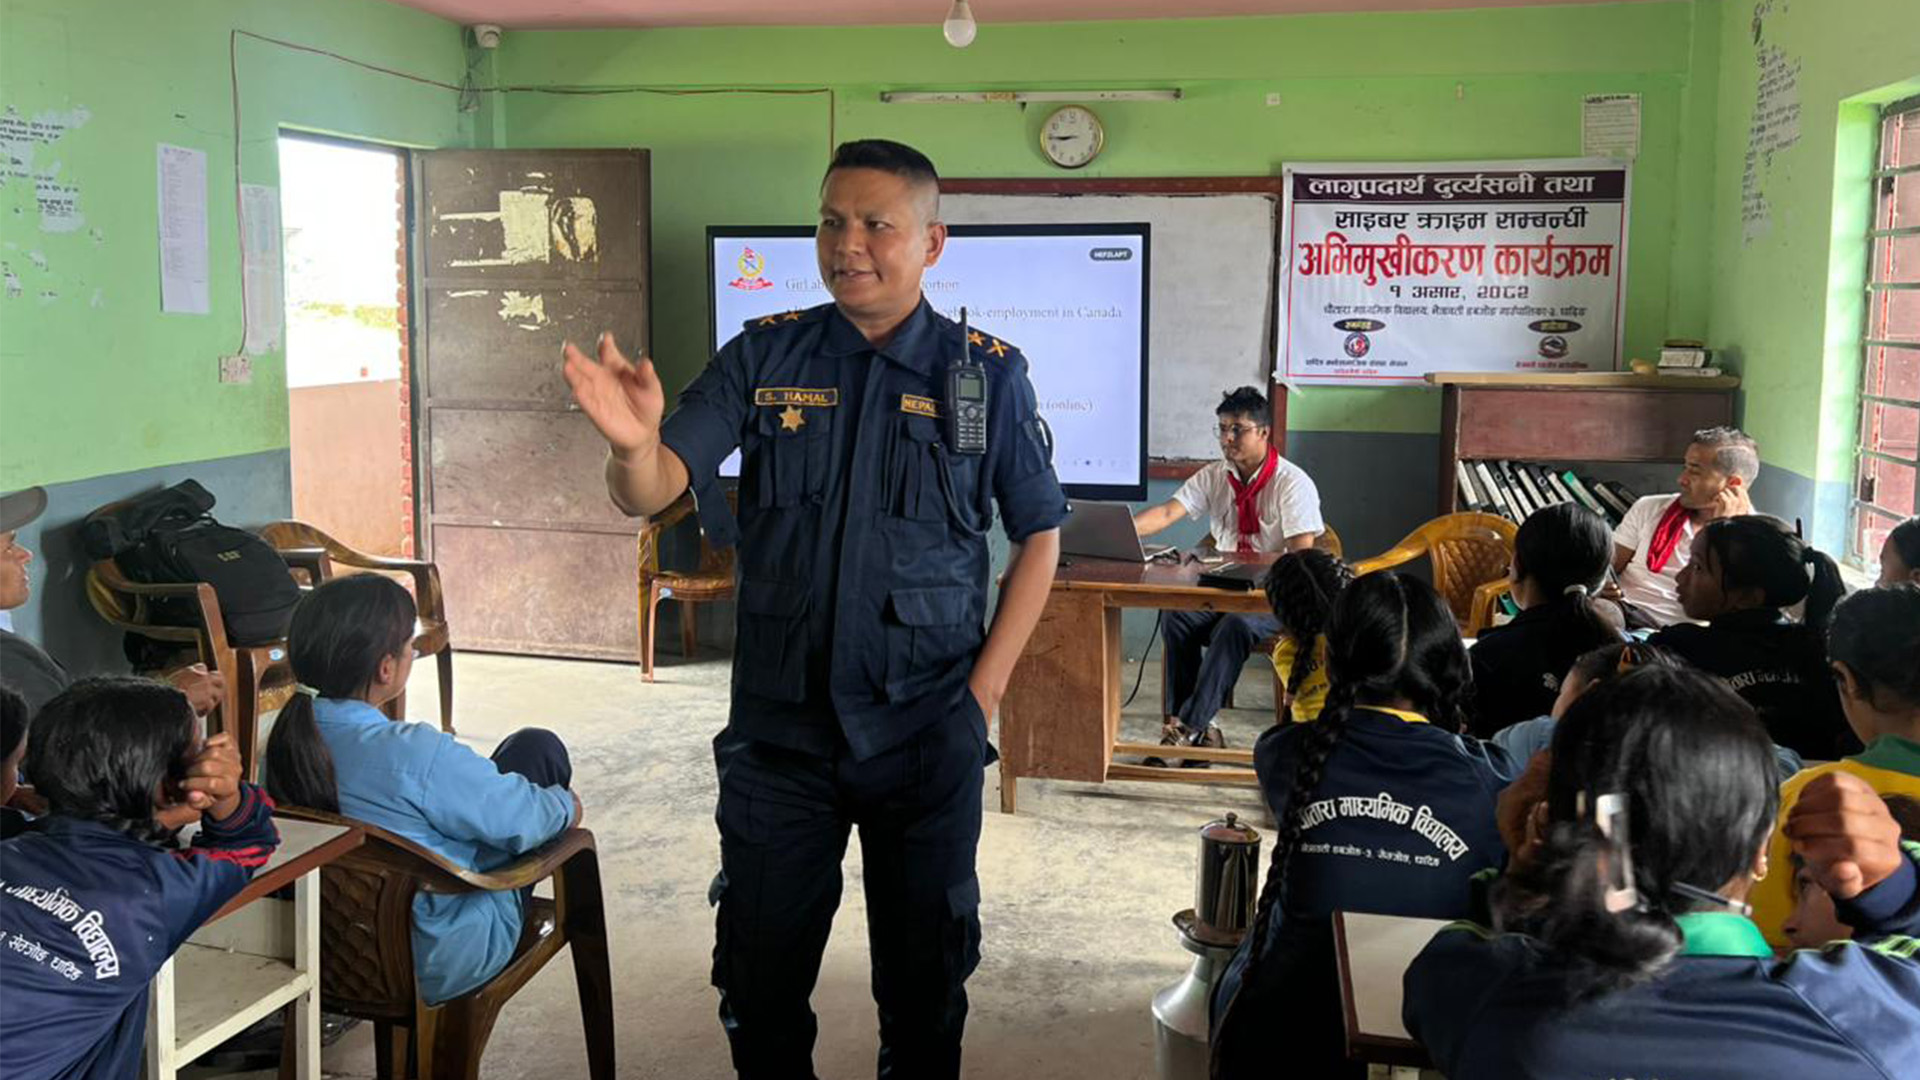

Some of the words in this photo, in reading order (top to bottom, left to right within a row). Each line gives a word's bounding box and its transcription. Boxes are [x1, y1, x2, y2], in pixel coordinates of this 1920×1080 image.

[1308, 174, 1426, 199] लागुपदार्थ
[1543, 176, 1596, 194] तथा
[1335, 210, 1410, 232] साइबर
[1417, 211, 1489, 232] क्राइम
[1496, 205, 1589, 229] सम्बन्धी
[1298, 231, 1487, 286] अभिमुखीकरण
[1494, 233, 1615, 279] कार्यक्रम
[1389, 285, 1401, 299] १
[1338, 792, 1413, 825] माध्यमिक
[1411, 805, 1470, 861] विद्यालय
[71, 910, 120, 980] विद्यालय
